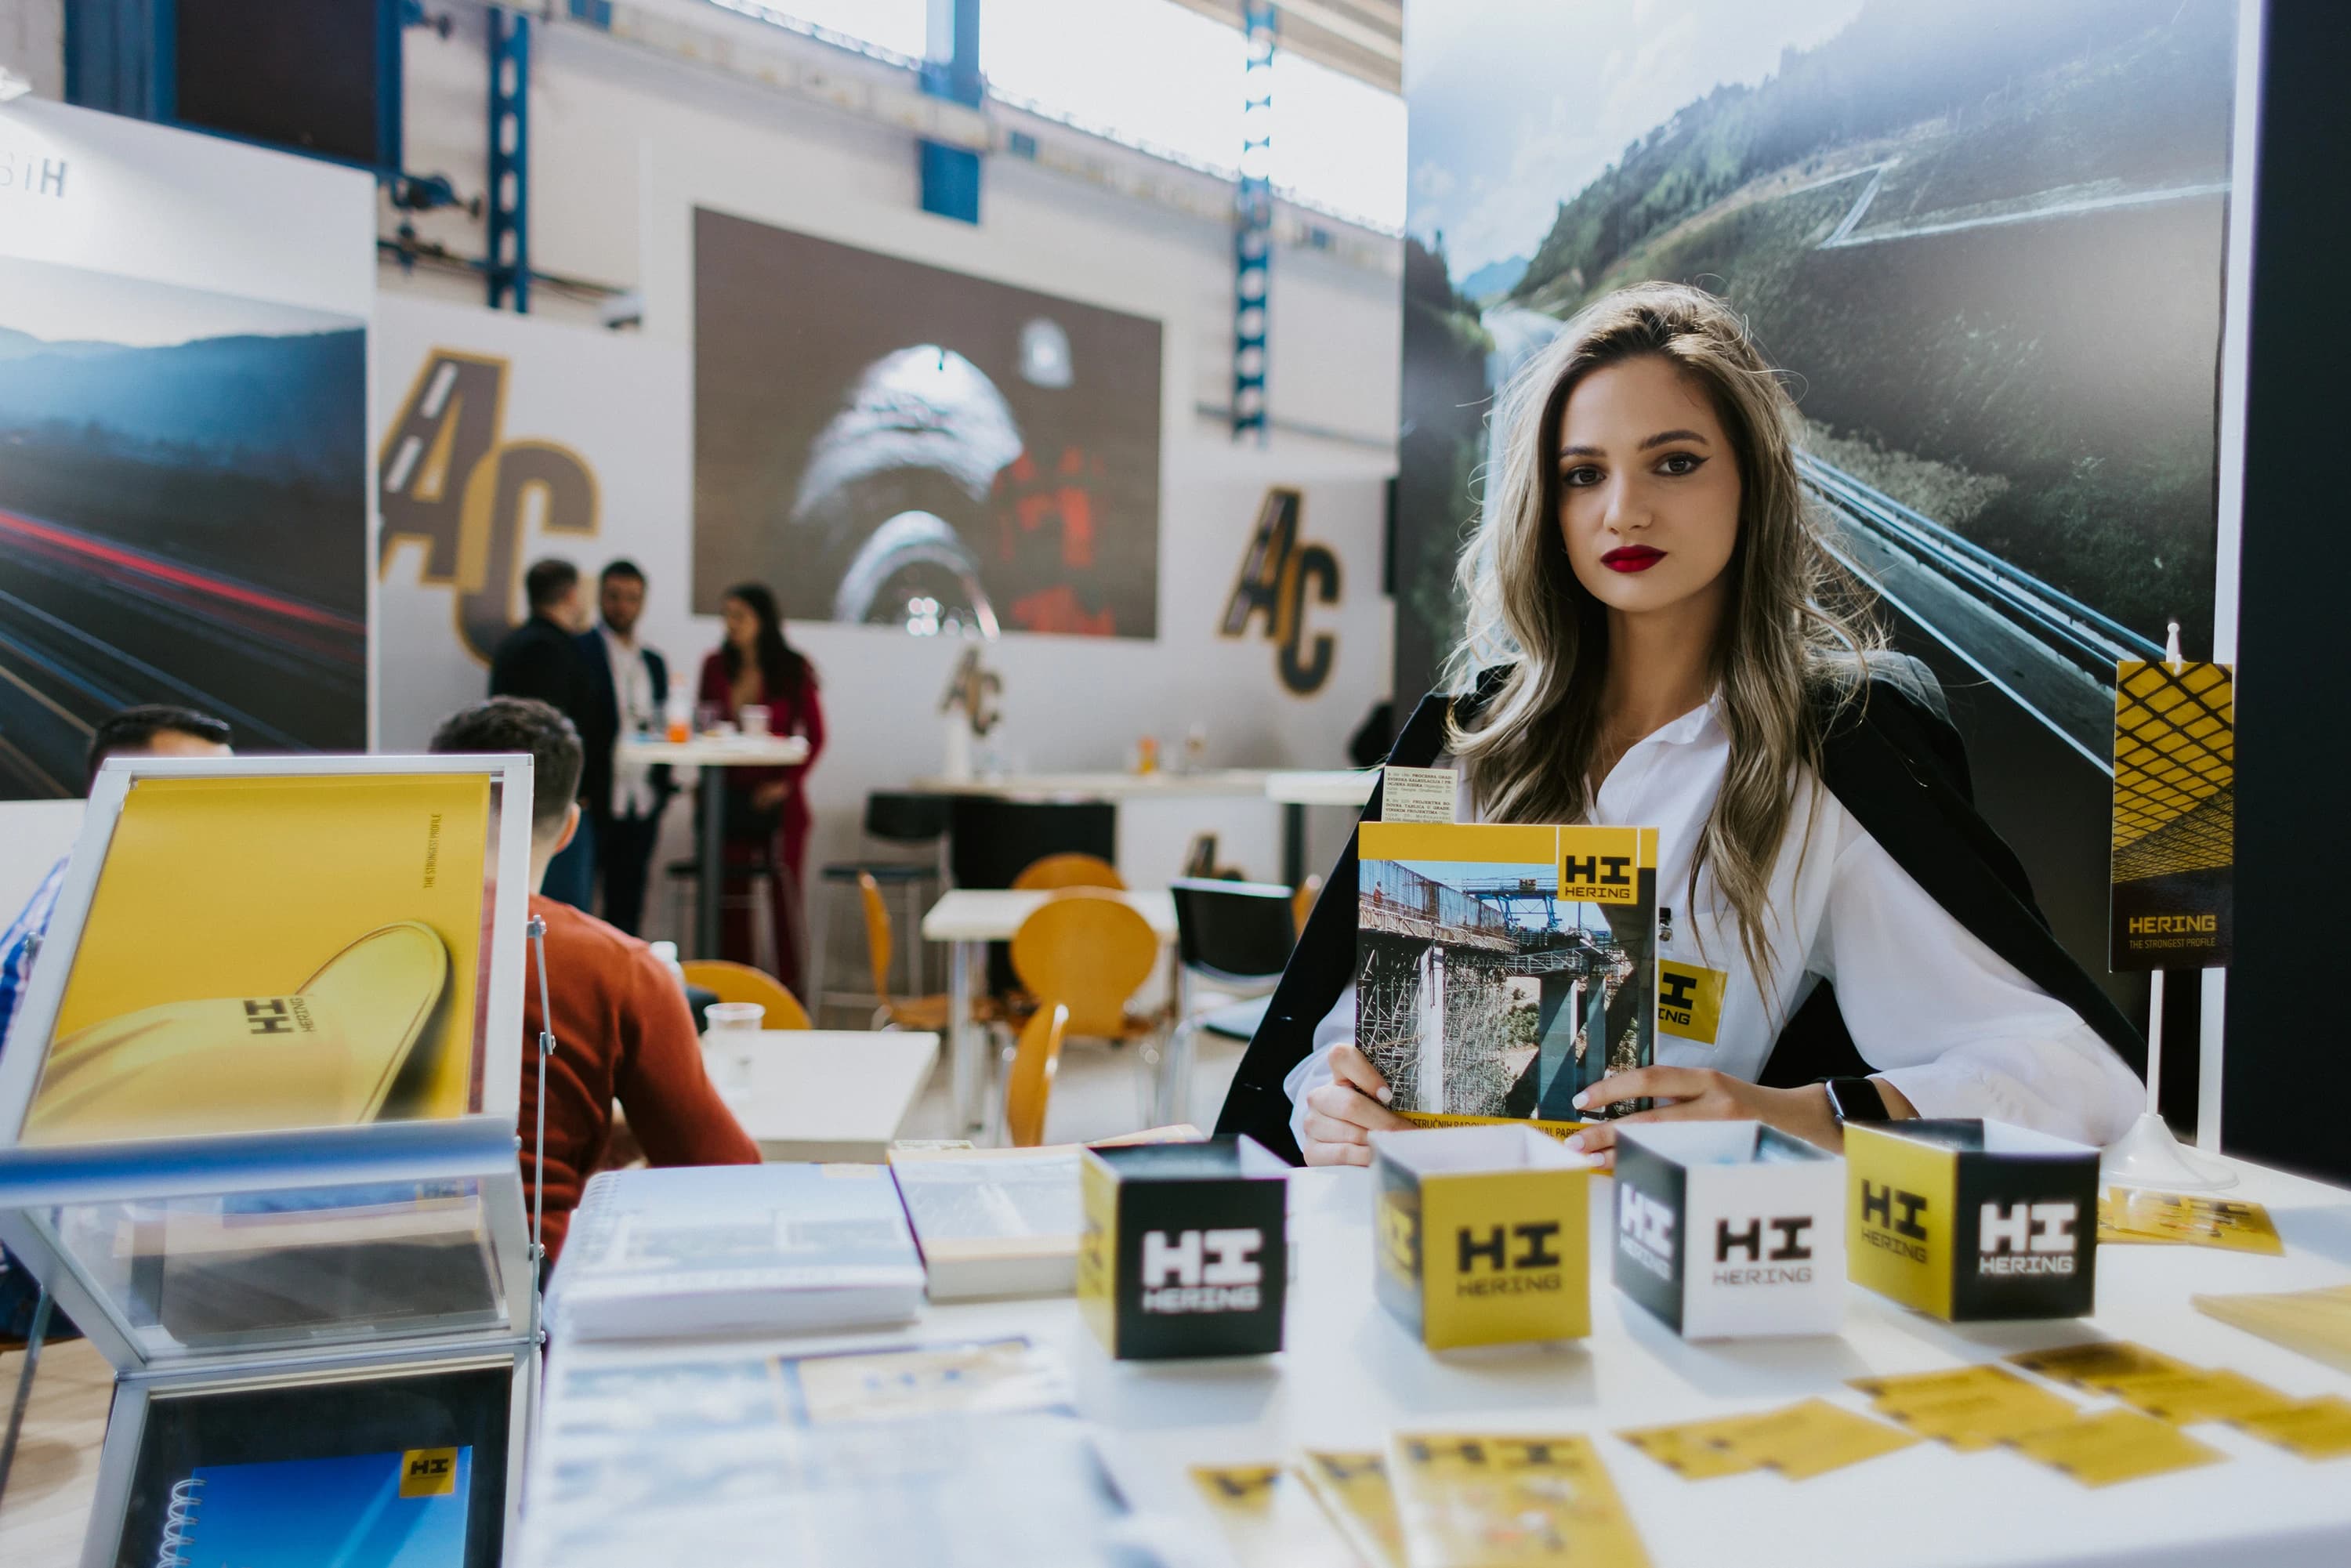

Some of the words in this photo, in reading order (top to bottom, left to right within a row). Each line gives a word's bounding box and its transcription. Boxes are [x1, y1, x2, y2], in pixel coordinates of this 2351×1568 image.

[1219, 485, 1341, 697] AC
[1566, 855, 1631, 885] HI
[1565, 886, 1630, 899] HERING
[2128, 914, 2217, 934] HERING
[2129, 940, 2144, 950] THE
[2145, 939, 2185, 949] STRONGEST
[2186, 937, 2216, 947] PROFILE
[1659, 972, 1697, 1010] I
[243, 998, 295, 1034] HI
[289, 998, 317, 1034] HERING
[1658, 1008, 1691, 1026] ING
[1860, 1178, 1928, 1242] HI
[1715, 1216, 1813, 1262] HI
[1979, 1203, 2077, 1253] HI
[1142, 1229, 1262, 1287] HI
[1458, 1222, 1561, 1273] HI
[1861, 1226, 1927, 1265] HERING
[1713, 1267, 1813, 1287] HERING
[1978, 1255, 2074, 1274] HERING
[1143, 1287, 1261, 1314] HERING
[1457, 1273, 1561, 1298] HERING
[410, 1458, 449, 1476] HI
